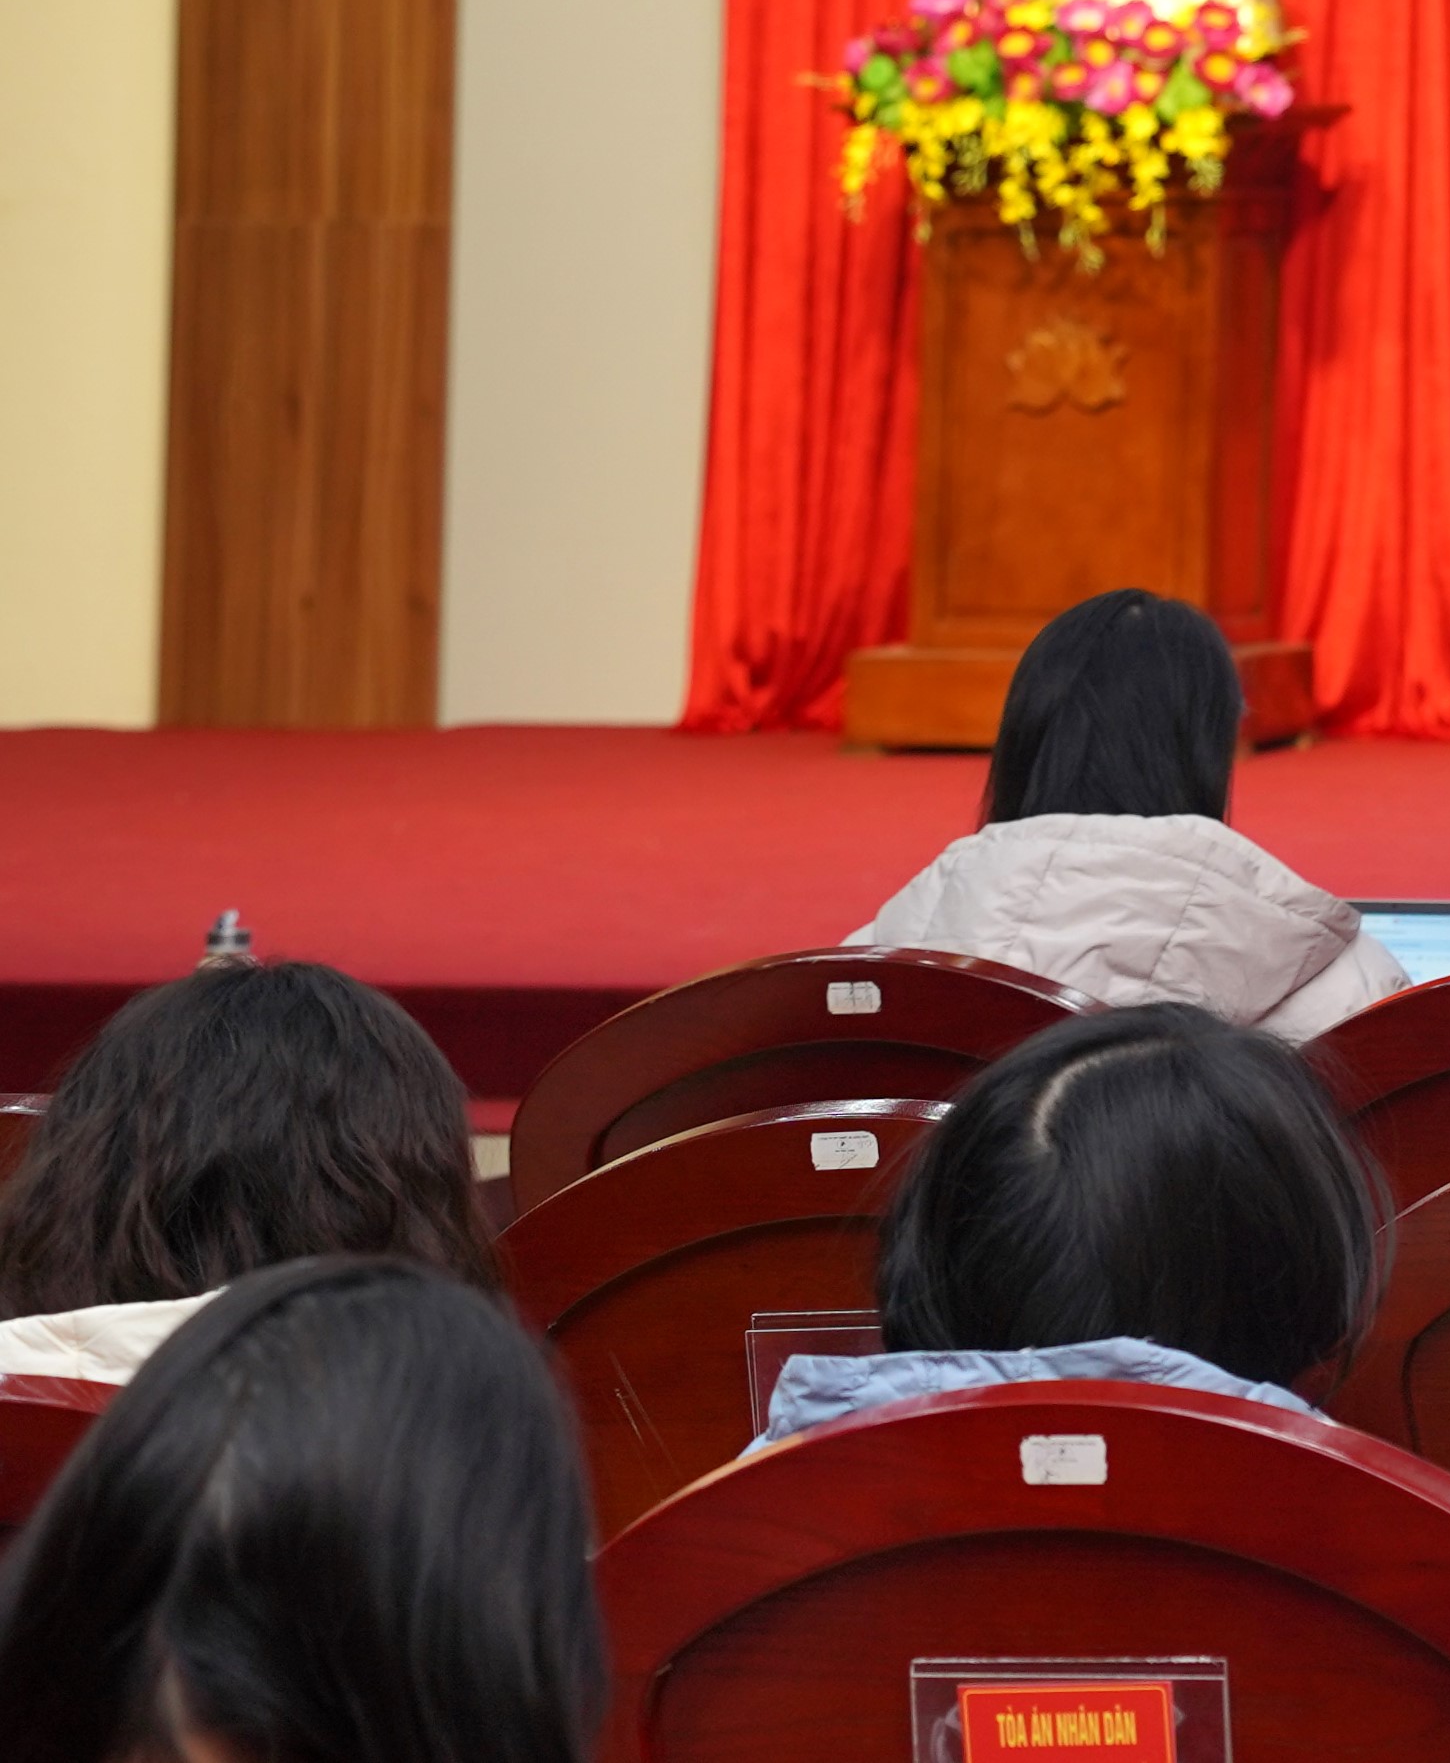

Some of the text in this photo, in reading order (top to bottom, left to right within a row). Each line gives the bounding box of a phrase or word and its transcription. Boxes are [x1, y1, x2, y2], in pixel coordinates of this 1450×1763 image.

[996, 1703, 1138, 1748] TÒA ÁN NHÂN DÂN
